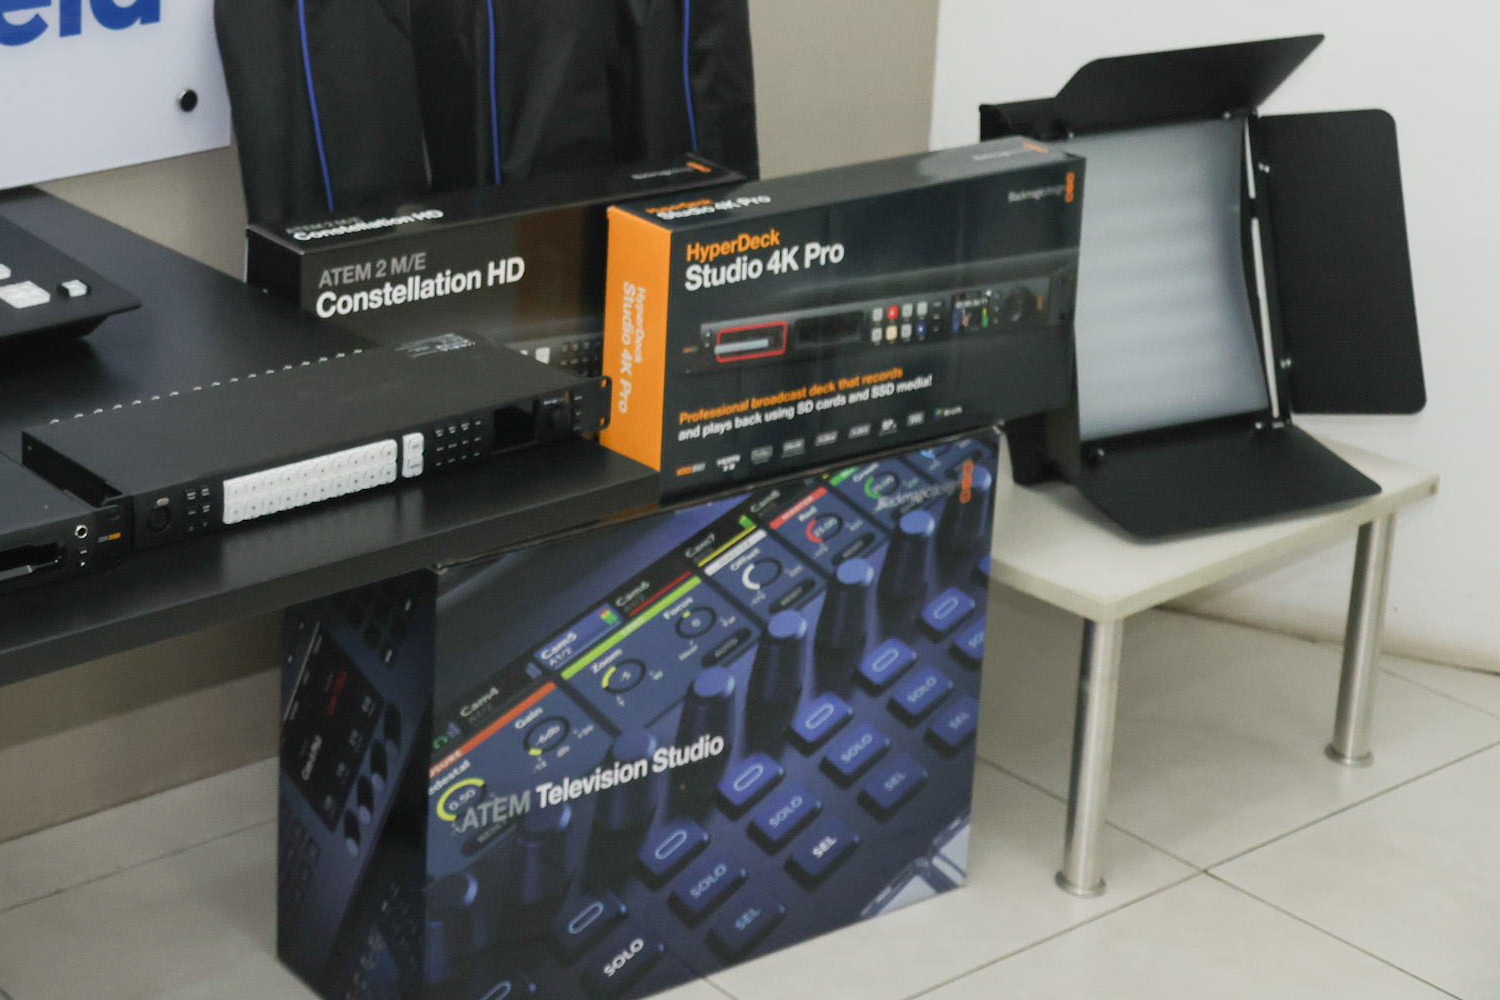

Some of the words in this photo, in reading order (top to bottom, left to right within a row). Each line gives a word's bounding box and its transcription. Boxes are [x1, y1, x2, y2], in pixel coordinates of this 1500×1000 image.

[293, 213, 415, 241] Constellation
[686, 228, 781, 263] HyperDeck
[318, 260, 372, 290] ATEM
[376, 259, 387, 279] 2
[390, 252, 427, 276] M/E
[685, 256, 764, 292] Studio
[766, 245, 801, 275] 4K
[804, 241, 845, 269] Pro
[316, 269, 482, 319] Constellation
[487, 256, 526, 287] HD
[621, 281, 636, 346] Studio
[619, 348, 632, 376] 4K
[618, 378, 632, 414] Pro
[678, 424, 701, 441] and
[702, 420, 733, 439] plays
[734, 412, 763, 429] back
[764, 405, 795, 421] using
[796, 399, 814, 415] SD
[815, 393, 847, 411] cards
[848, 388, 870, 404] and
[870, 382, 895, 399] SSD
[896, 374, 933, 393] media!
[679, 397, 750, 425] Professional
[751, 386, 807, 409] broadcast
[809, 380, 836, 397] deck
[837, 375, 860, 391] that
[861, 367, 903, 385] records
[540, 631, 578, 660] Cam5
[460, 685, 499, 718] Cam4
[906, 675, 937, 704] SOLO
[840, 733, 874, 764] SOLO
[461, 789, 532, 833] ATEM
[536, 758, 649, 808] Television
[651, 732, 725, 774] Studio
[884, 771, 907, 791] SEL
[768, 795, 804, 829] SOLO
[812, 836, 838, 859] SEL
[689, 862, 728, 900] SOLO
[734, 906, 762, 932] SEL
[603, 938, 645, 978] SOLO
